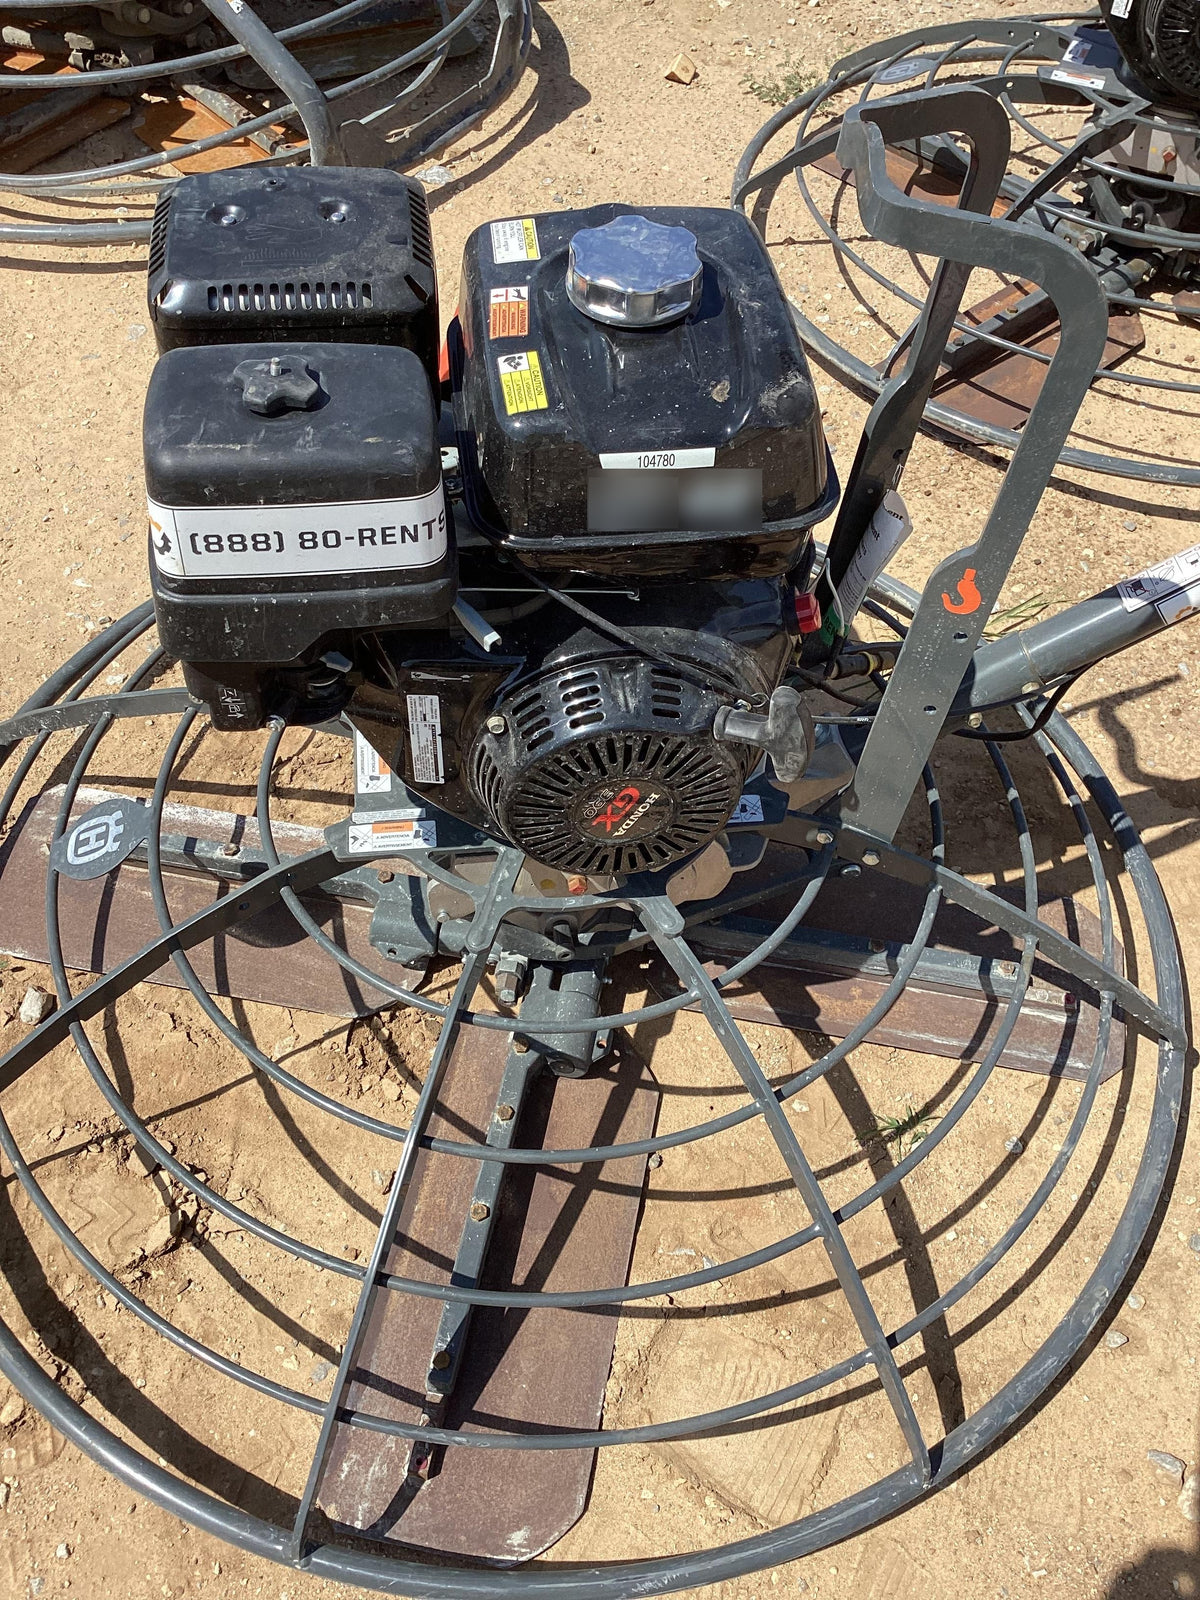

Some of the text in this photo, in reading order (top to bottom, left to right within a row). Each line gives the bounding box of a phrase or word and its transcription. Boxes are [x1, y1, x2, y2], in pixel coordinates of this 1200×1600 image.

[532, 369, 543, 396] CAUTION
[637, 453, 676, 468] 104780
[189, 508, 446, 555] (888) 80-RENTS
[591, 787, 640, 832] GX
[612, 792, 661, 837] HONDA
